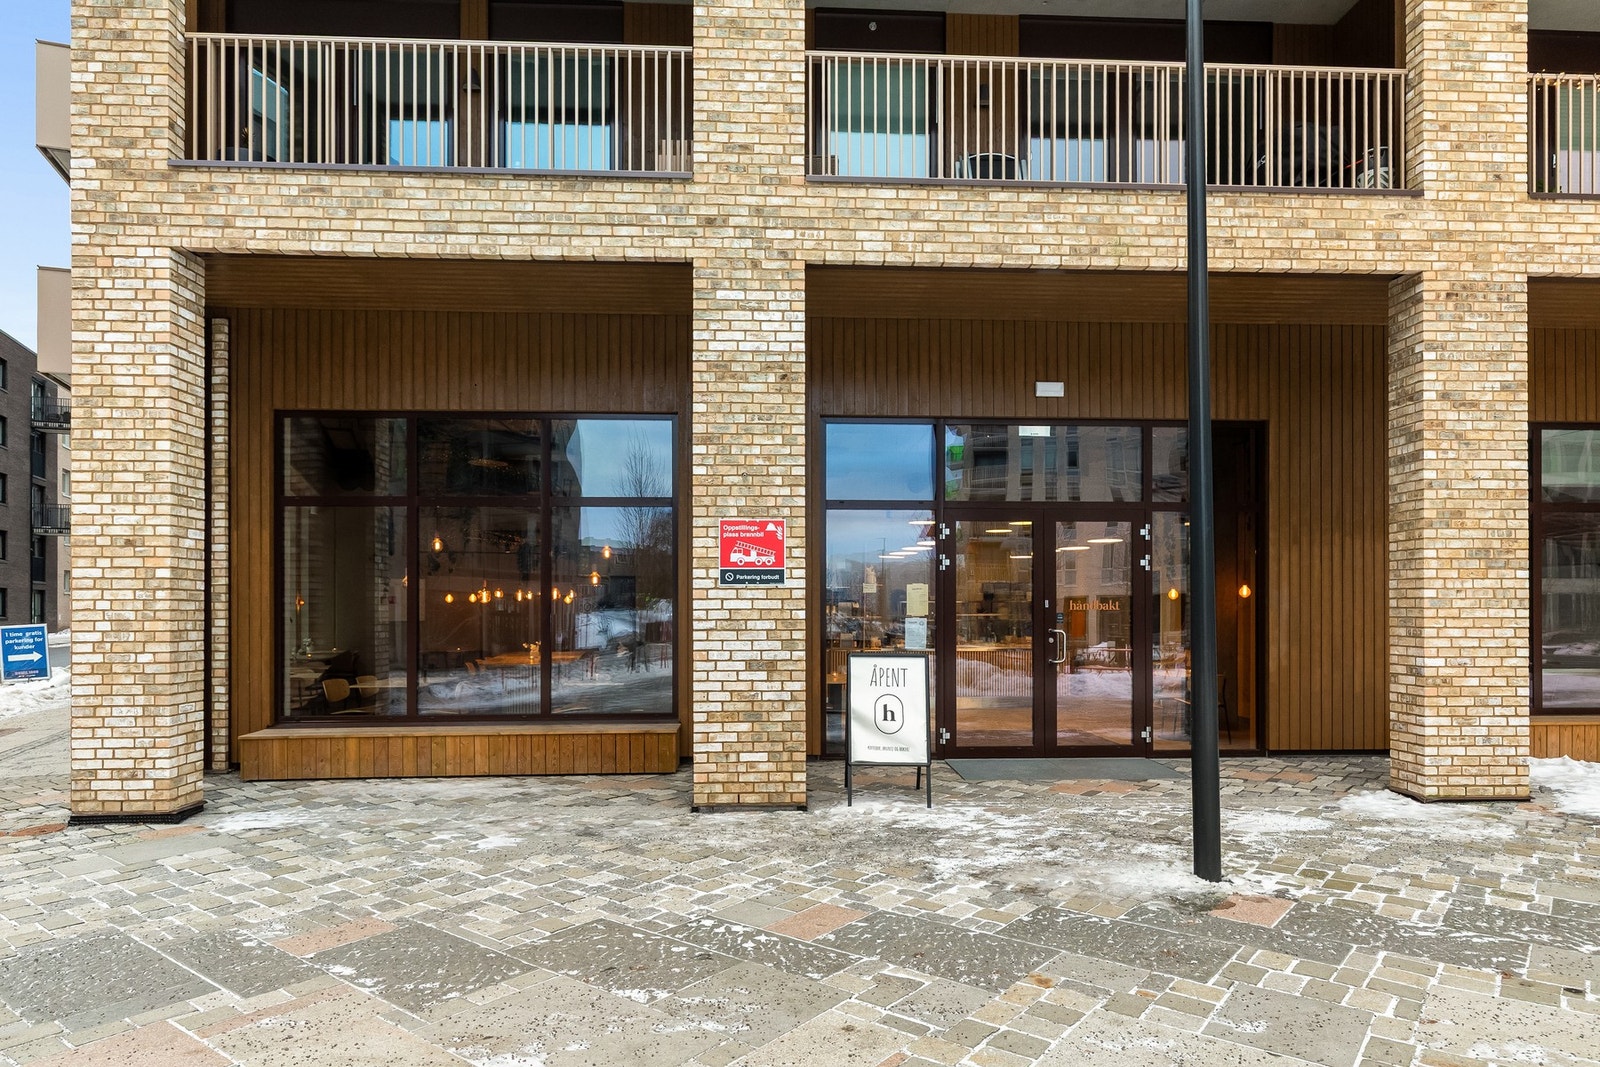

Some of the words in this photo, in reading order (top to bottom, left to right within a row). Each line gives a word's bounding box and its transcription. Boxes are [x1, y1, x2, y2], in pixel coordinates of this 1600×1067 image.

[723, 524, 760, 532] Oppstillings-
[1069, 599, 1120, 611] håndbakt
[869, 663, 908, 687] ÅPENT
[882, 703, 896, 722] h
